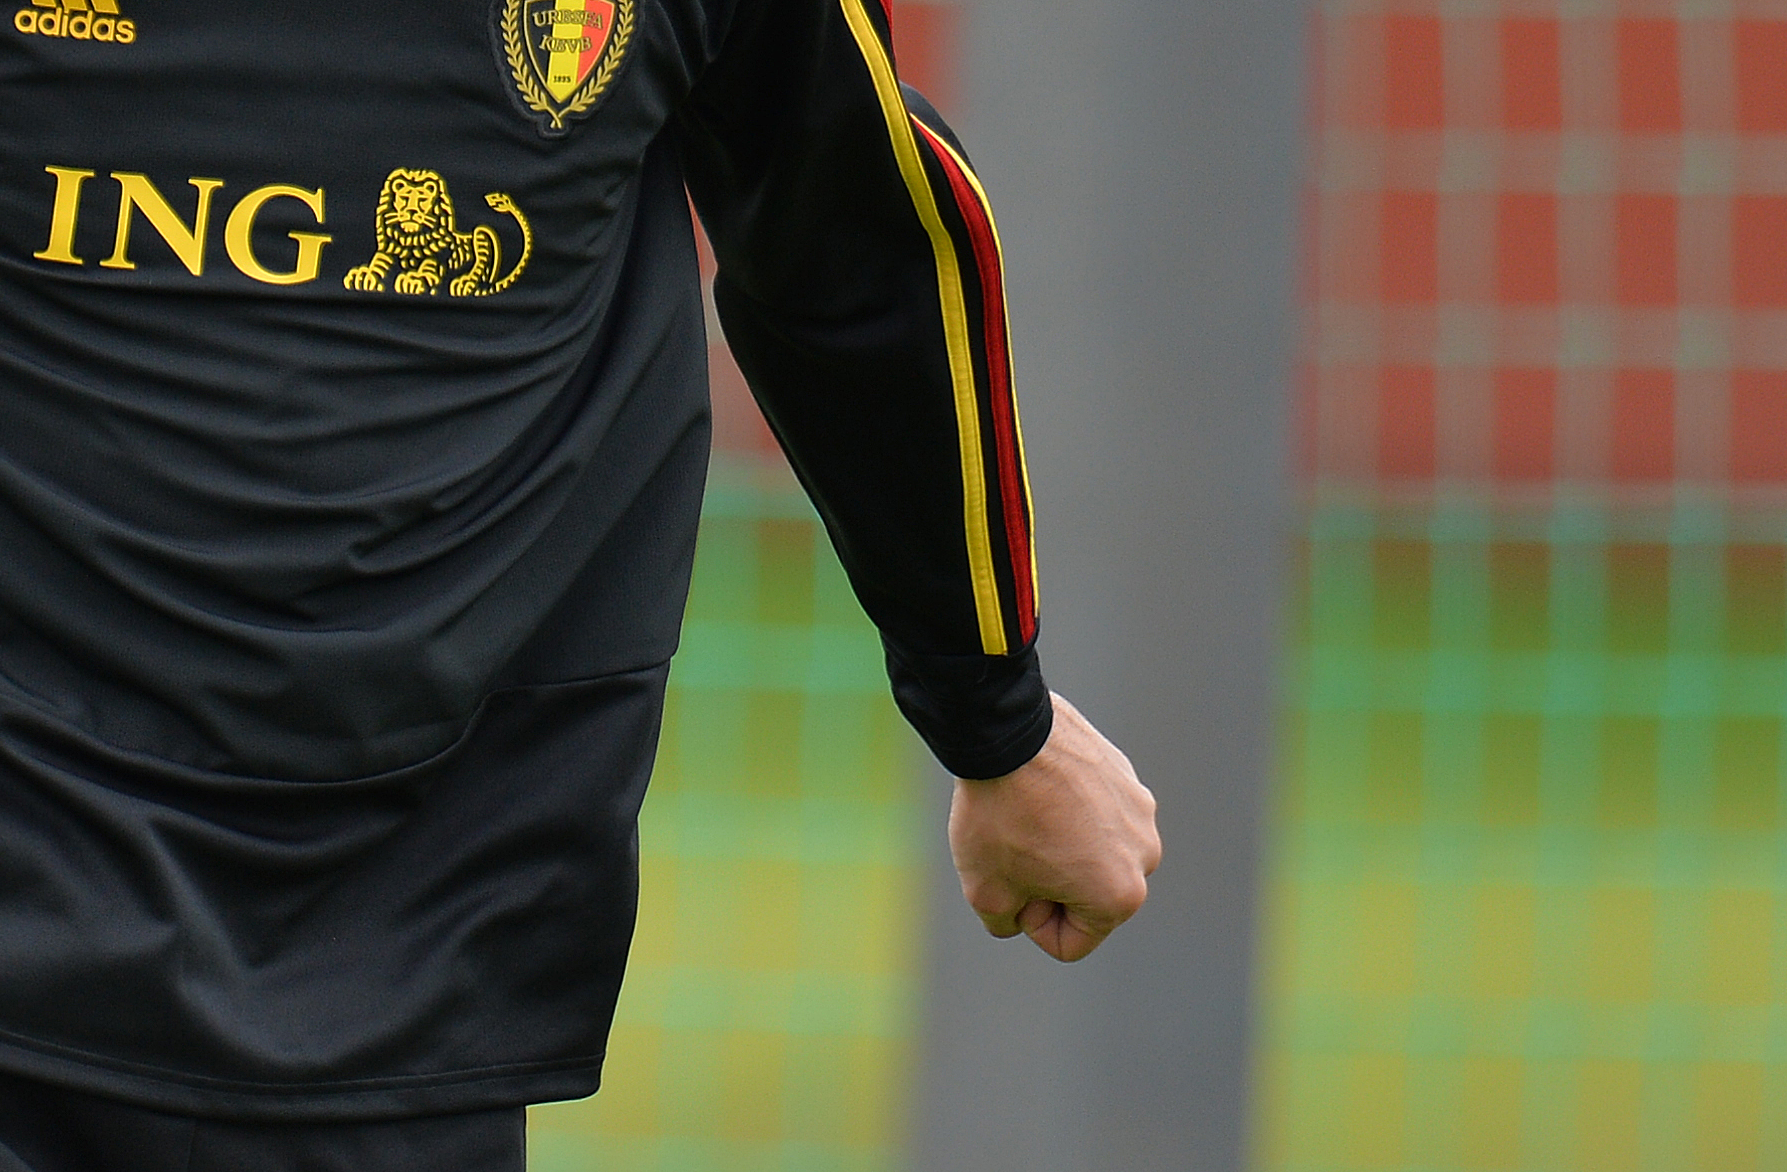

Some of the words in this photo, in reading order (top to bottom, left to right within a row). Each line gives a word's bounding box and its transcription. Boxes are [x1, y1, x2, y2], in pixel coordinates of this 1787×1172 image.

[14, 7, 135, 43] adidas
[532, 9, 603, 30] URBSFA
[539, 34, 592, 53] KBVB
[33, 165, 332, 285] ING
